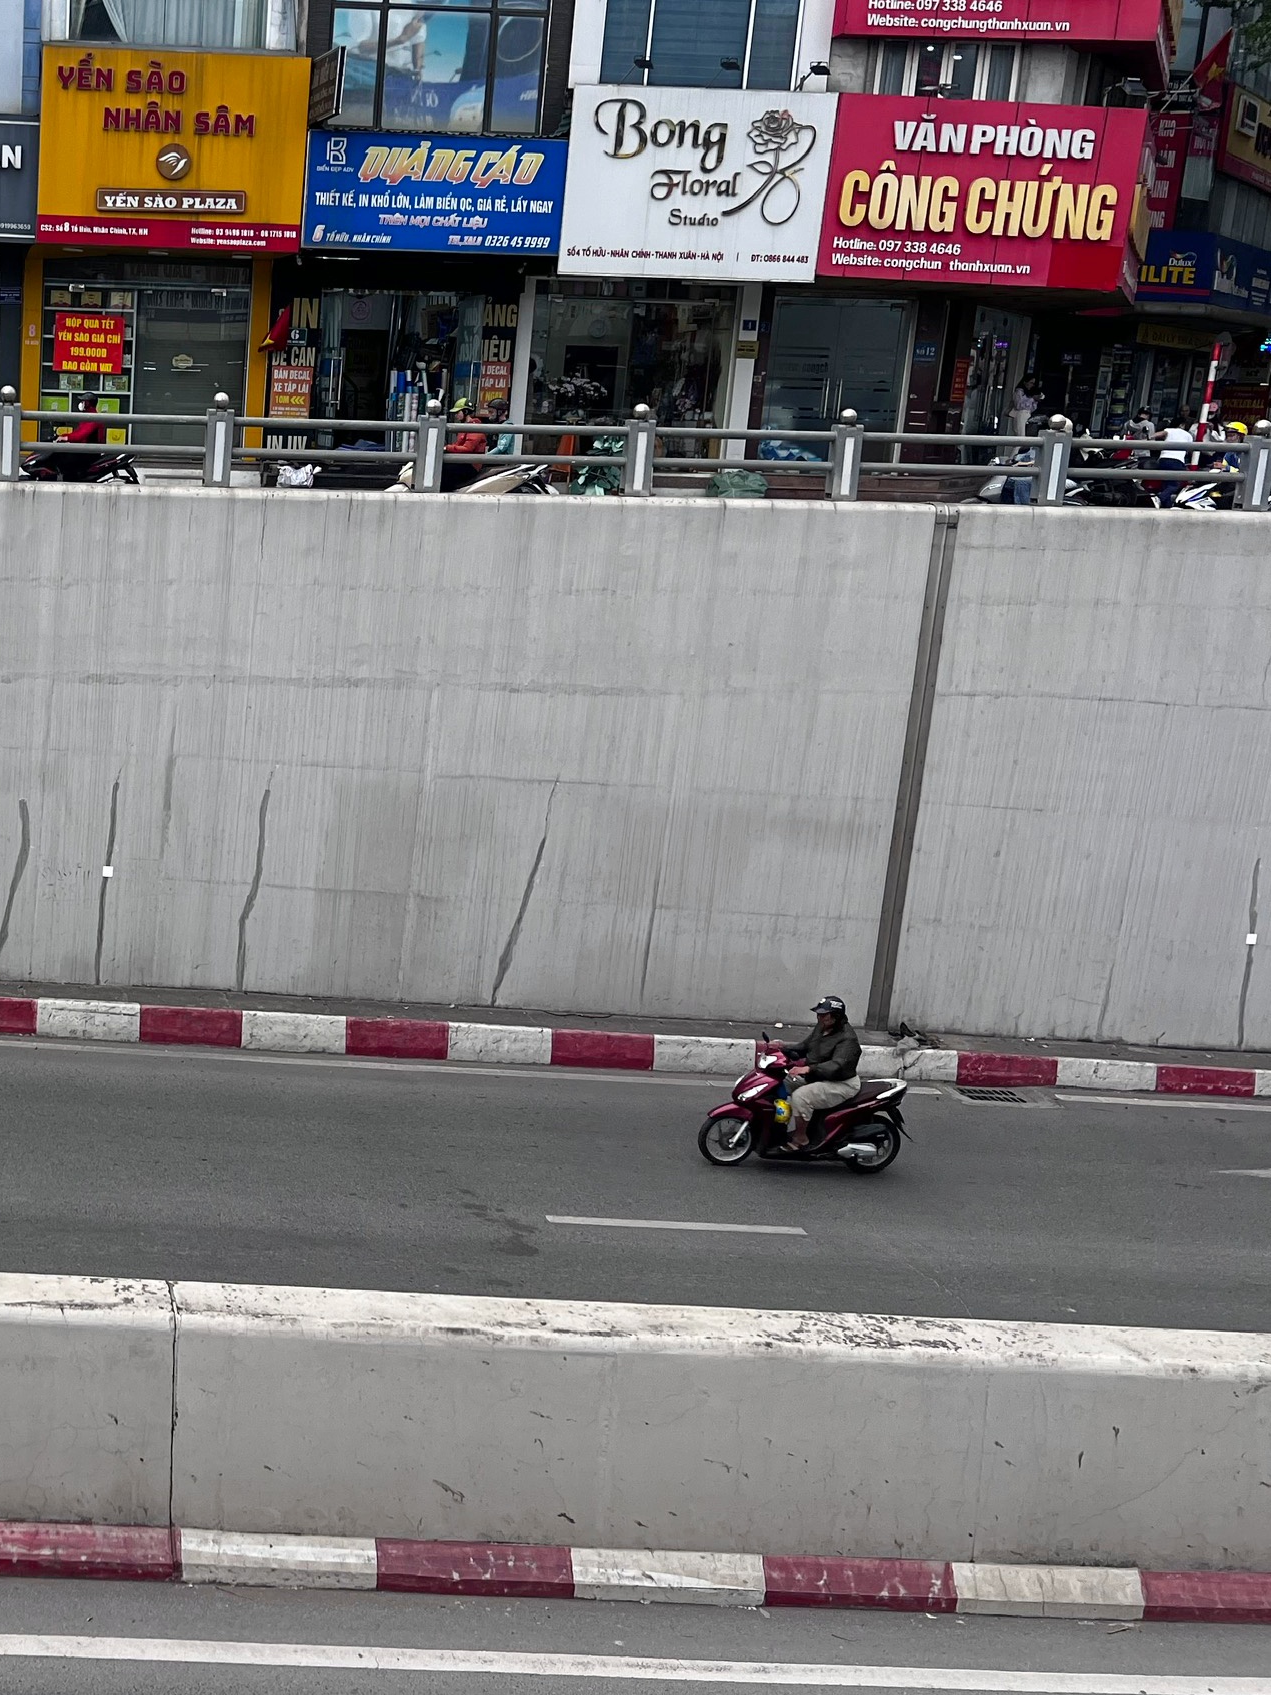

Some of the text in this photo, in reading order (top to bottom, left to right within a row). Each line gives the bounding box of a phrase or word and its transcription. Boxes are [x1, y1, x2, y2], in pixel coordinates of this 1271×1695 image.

[916, 0, 1003, 12] 097 338 4646
[867, 13, 1071, 33] Website: congchungthanhxuan.vn
[56, 52, 187, 94] YẾN SÀO
[102, 100, 256, 137] NHÂN SÂM
[594, 97, 728, 174] Bong
[893, 113, 1096, 160] VĂN PHÒNG
[357, 140, 545, 189] QUẢNG CÁO
[650, 168, 742, 201] Floral
[104, 191, 238, 210] YẾN SÀO PLAZA
[315, 188, 341, 206] THIẾT
[341, 189, 357, 208] KẾ,
[358, 193, 369, 207] IN
[370, 189, 390, 208] KHỔ
[414, 192, 434, 210] LÀM
[435, 191, 457, 211] BIỂN
[459, 197, 475, 212] QC,
[477, 196, 492, 212] GIÁ
[494, 194, 509, 214] RẺ,
[510, 195, 529, 213] LẤY
[529, 200, 554, 214] NGAY
[838, 160, 960, 233] CÔNG
[965, 163, 1118, 241] CHỨNG
[40, 221, 70, 233] CS2: 8
[378, 212, 489, 230] TRÊN MỌI CHẤT LIỆU
[668, 208, 719, 227] Studio
[216, 238, 266, 247] yensaoplaza.com
[312, 224, 551, 249] 6 CHÍNH 0326 45 9999
[832, 236, 961, 256] Hotline: 097 338 4646
[610, 248, 724, 263] NHÂN CHÍNH THANH XUÂN NỘI
[782, 254, 795, 263] 844
[796, 255, 809, 264] 483
[831, 253, 882, 267] Website:
[949, 260, 1031, 274] thanhxuan.vn
[1168, 257, 1196, 267] Dulux
[292, 297, 319, 329] IN
[65, 316, 115, 330] HỘP QUÀ TẾT
[58, 328, 72, 342] YẾN
[73, 331, 90, 343] SÀO
[91, 332, 105, 344] GIÁ
[62, 358, 98, 372] BAO GỒM
[290, 346, 316, 368] CAN
[273, 367, 311, 381] BÁN DECAL
[486, 365, 508, 376] DECAL
[273, 380, 309, 395] XE TẬP LÁI
